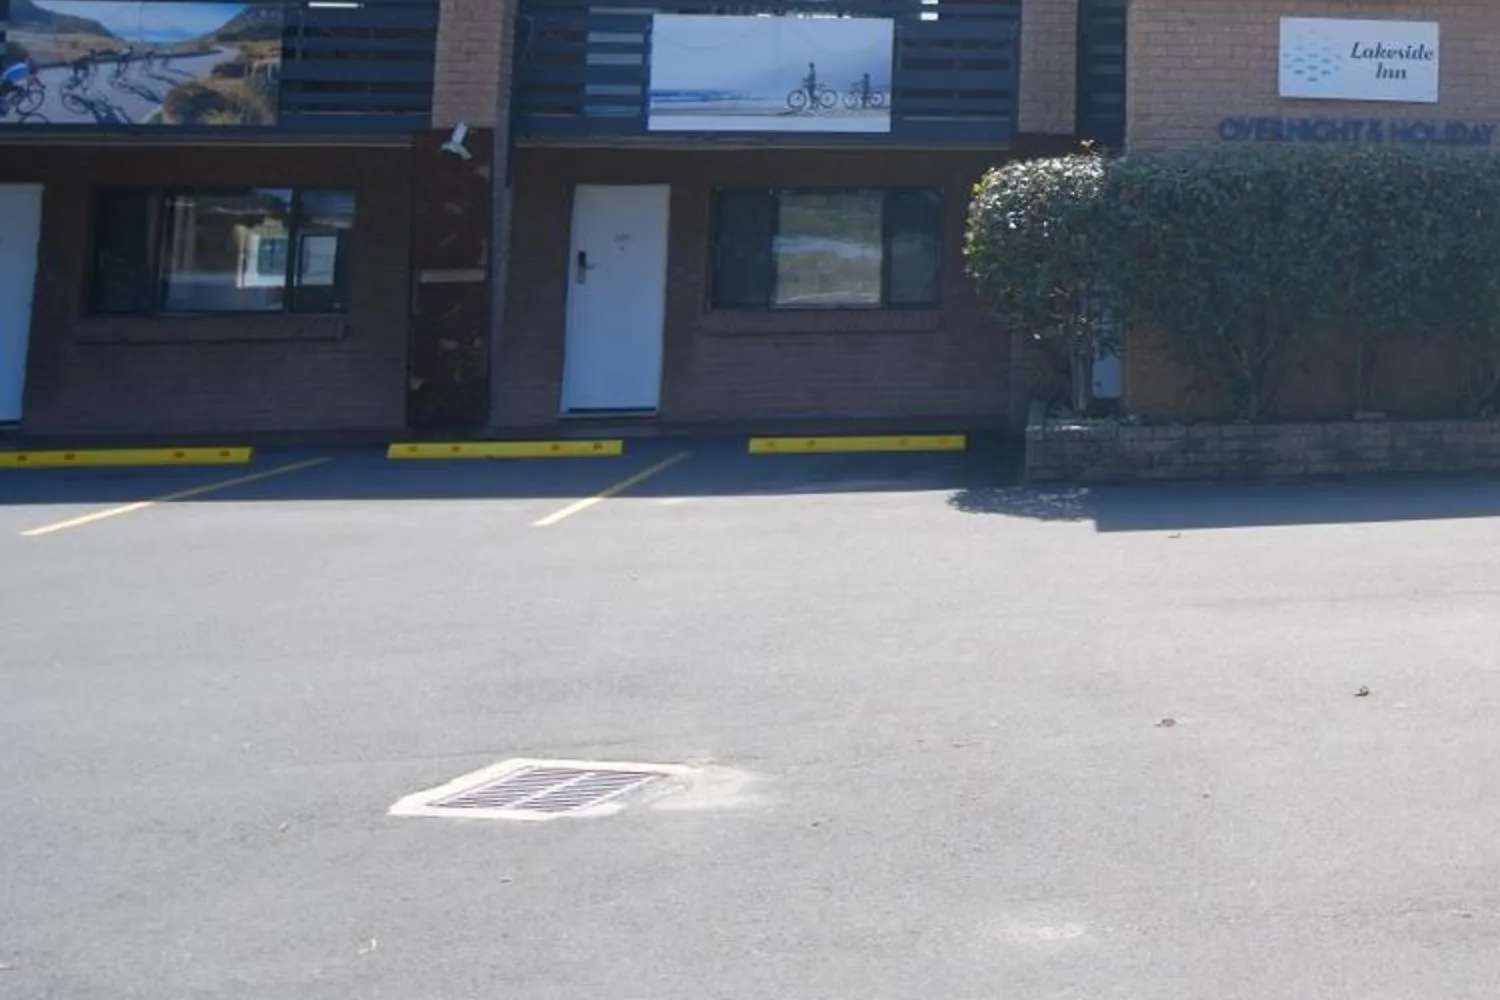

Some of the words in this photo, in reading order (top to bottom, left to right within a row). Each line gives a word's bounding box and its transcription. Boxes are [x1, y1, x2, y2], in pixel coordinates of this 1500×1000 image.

[1350, 41, 1434, 61] Lakeside
[1375, 61, 1407, 79] Inn
[1219, 117, 1365, 142] OVERNIGHT
[1391, 120, 1496, 145] HOLIDAY
